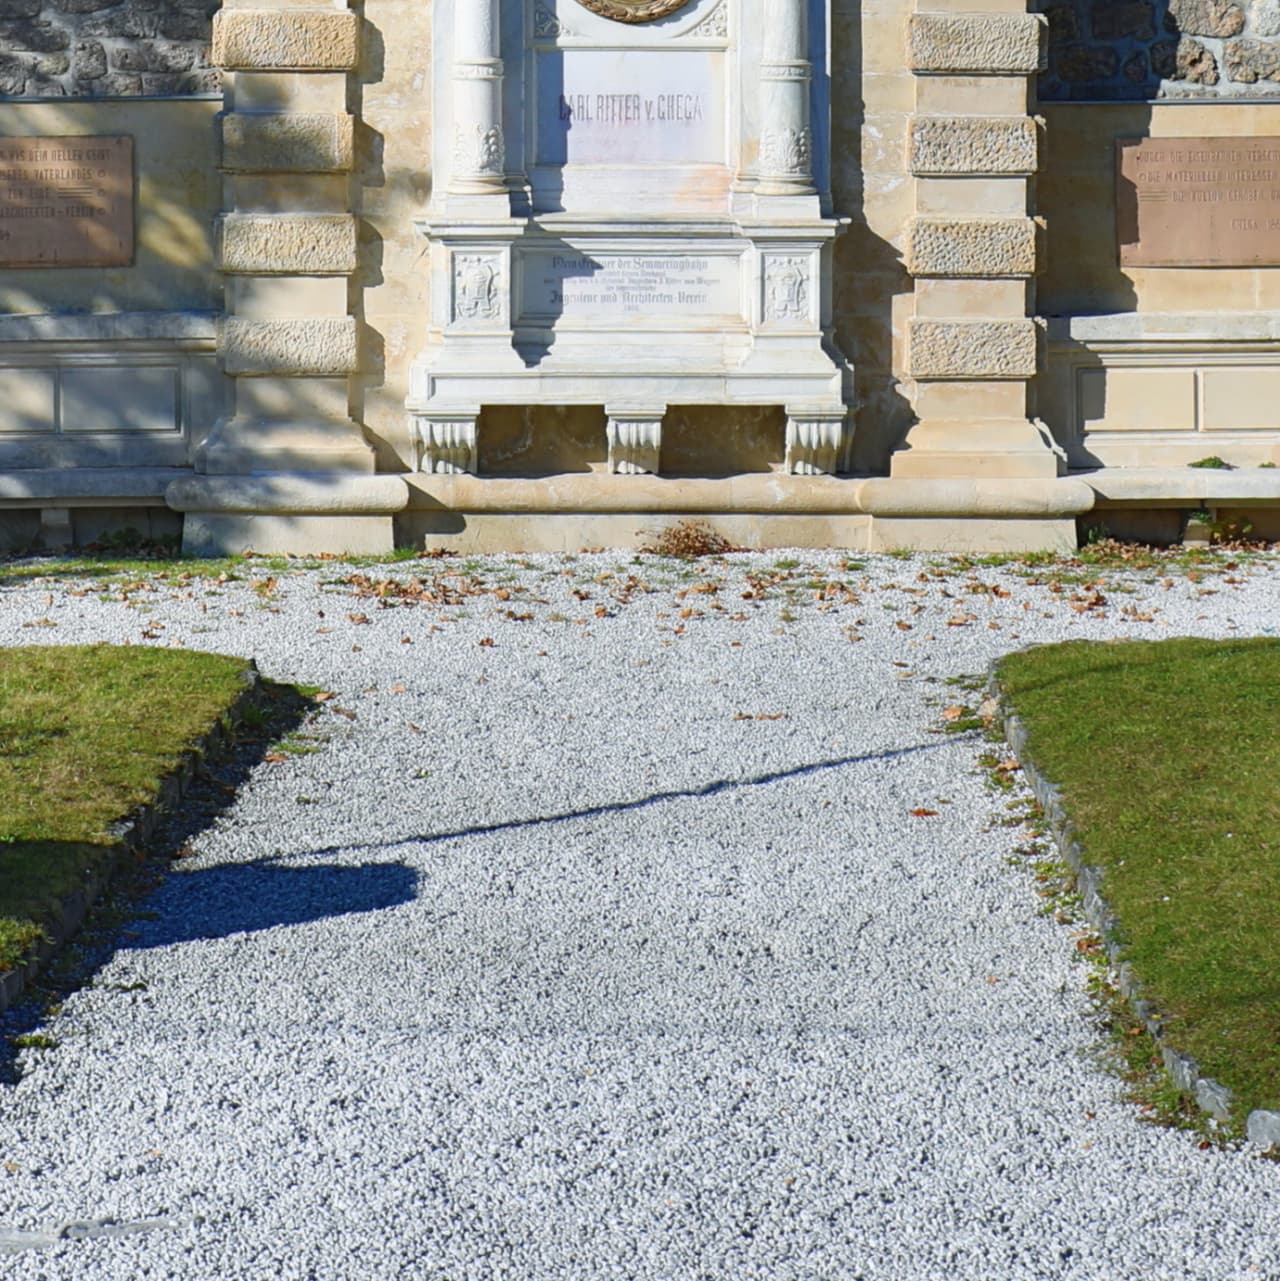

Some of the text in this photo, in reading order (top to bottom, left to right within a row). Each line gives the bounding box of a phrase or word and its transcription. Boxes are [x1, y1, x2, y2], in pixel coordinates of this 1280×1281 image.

[558, 94, 593, 121] CARL
[596, 94, 640, 121] RITTER
[657, 94, 704, 121] GHEGA
